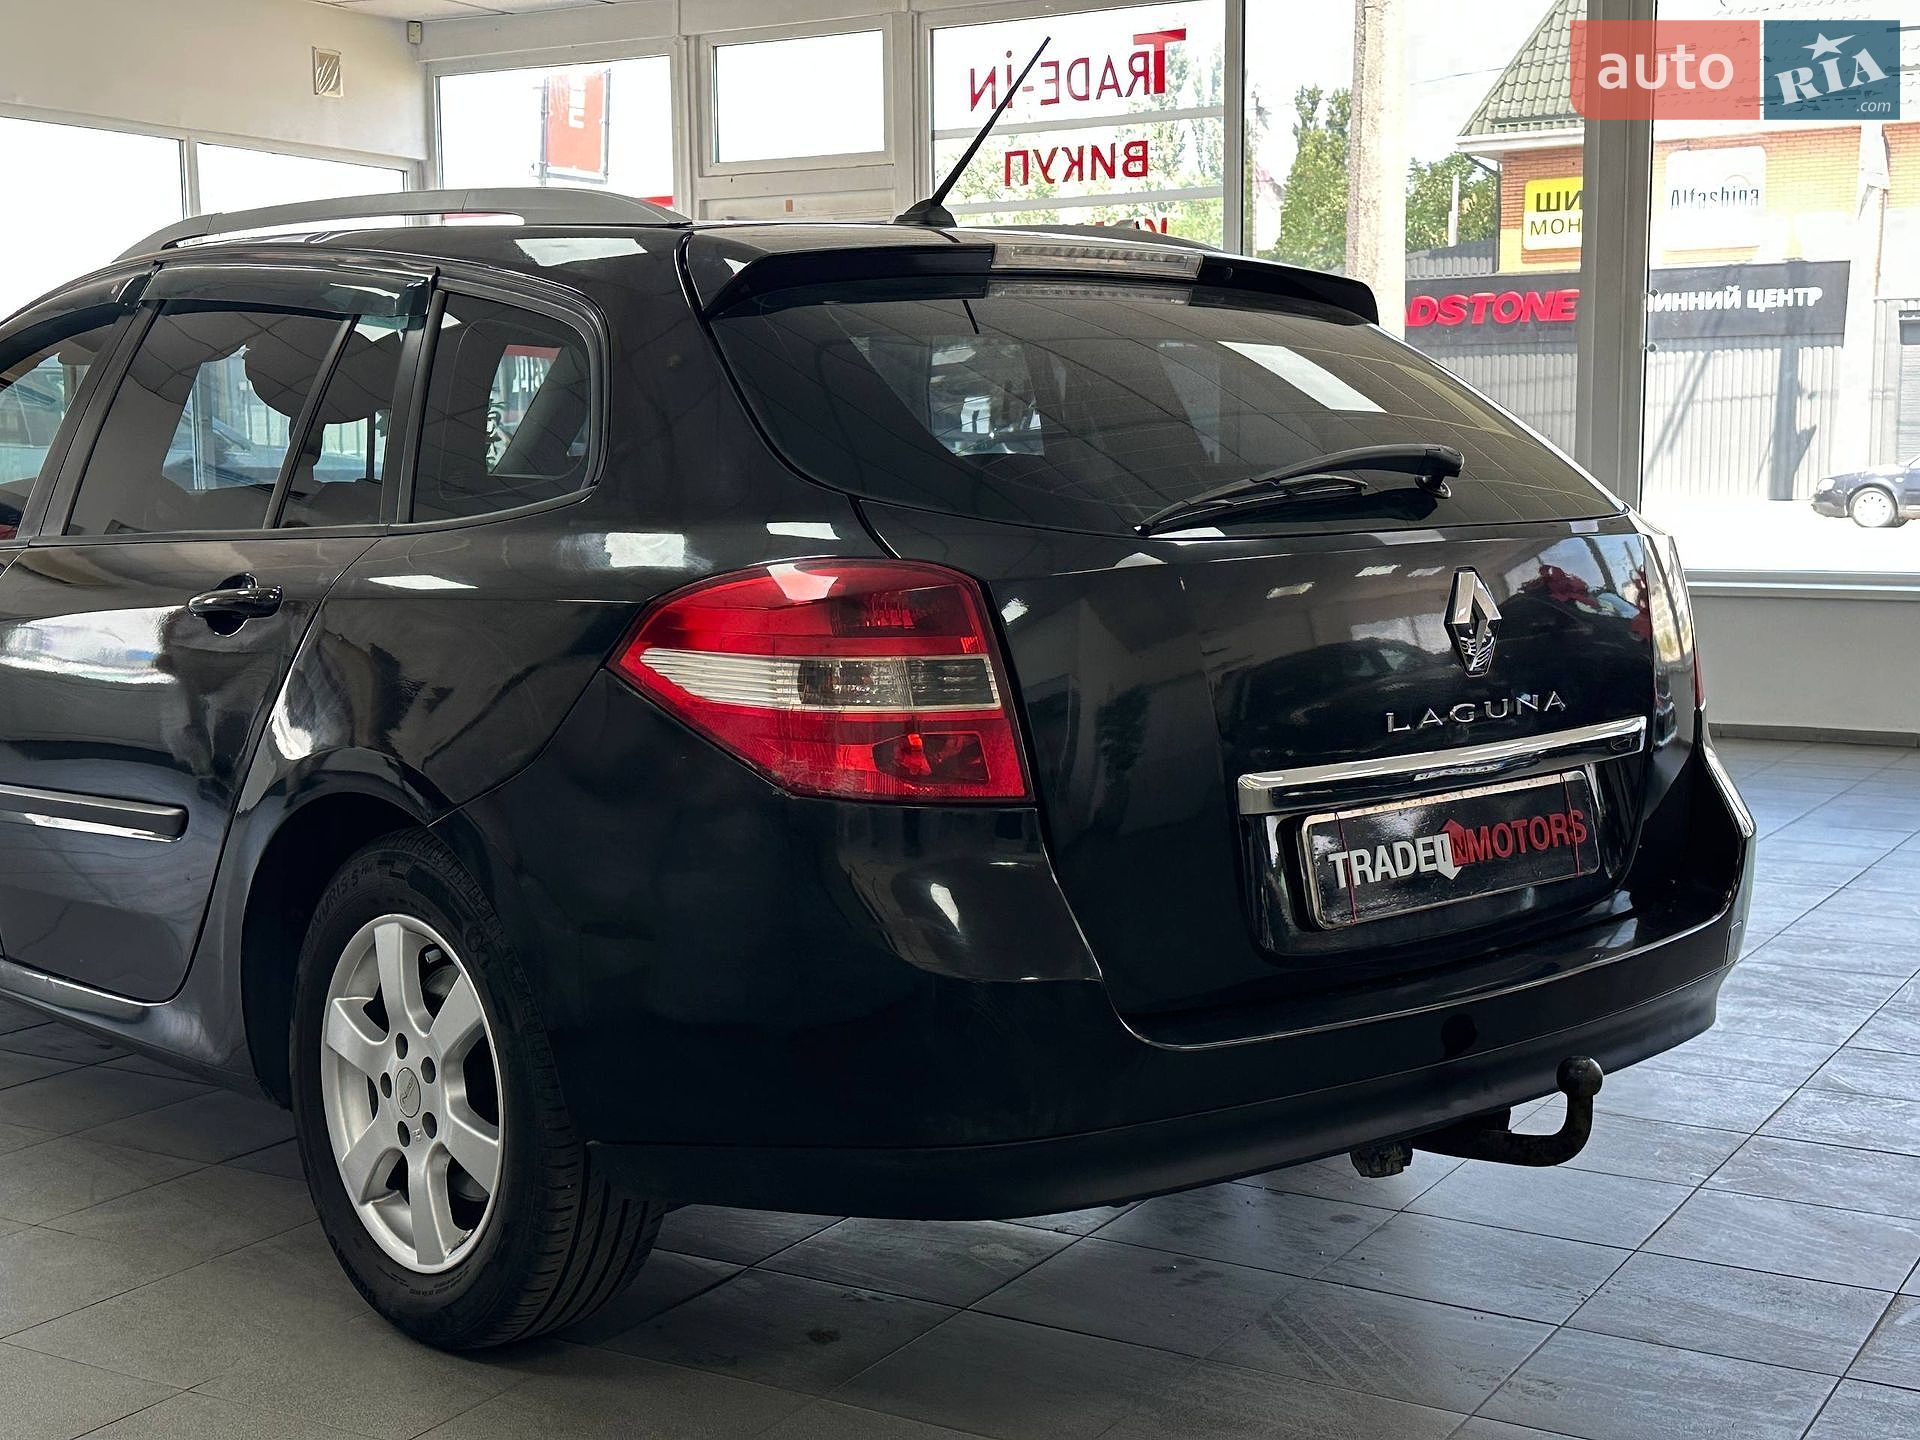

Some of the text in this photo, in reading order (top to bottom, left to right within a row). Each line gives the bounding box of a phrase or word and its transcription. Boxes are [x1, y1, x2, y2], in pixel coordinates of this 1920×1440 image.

[1405, 288, 1580, 327] DSTONE
[1747, 286, 1823, 312] ЦЕНТР
[1386, 690, 1567, 733] LAGUNA
